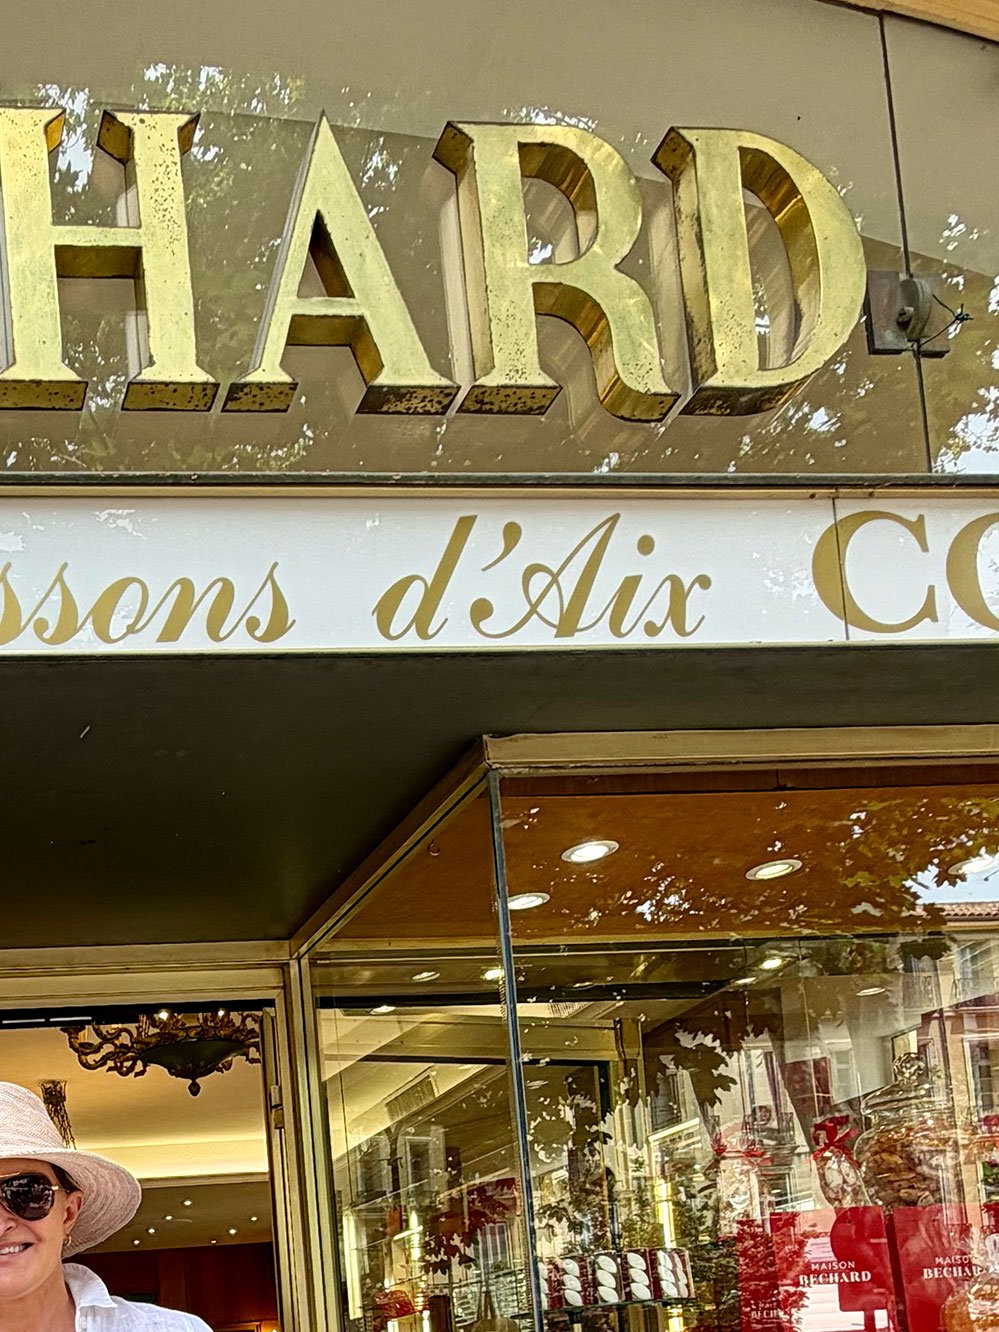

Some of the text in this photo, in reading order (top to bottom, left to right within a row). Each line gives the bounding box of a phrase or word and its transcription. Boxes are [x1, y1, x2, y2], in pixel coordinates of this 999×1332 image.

[372, 512, 713, 641] d'Aix
[811, 1260, 856, 1271] MAISON
[799, 1270, 872, 1286] BECHARD
